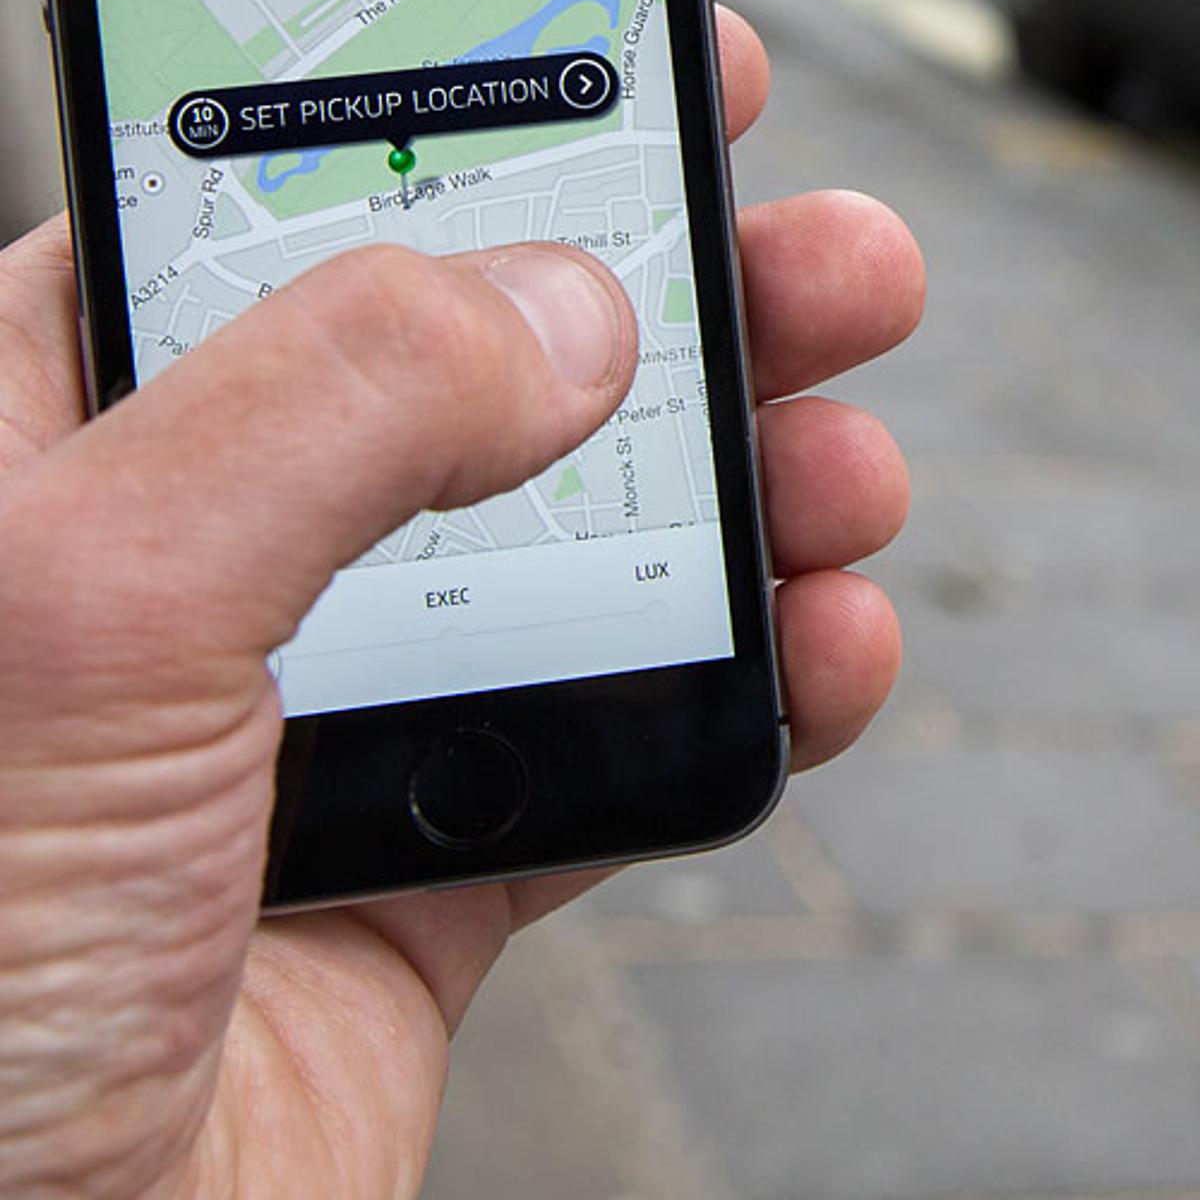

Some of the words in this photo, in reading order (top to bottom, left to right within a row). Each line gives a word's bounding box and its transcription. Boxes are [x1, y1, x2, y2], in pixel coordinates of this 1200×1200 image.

[621, 49, 637, 100] Horse
[193, 106, 213, 123] 10
[240, 103, 290, 131] SET
[299, 91, 402, 125] PICKUP
[412, 76, 549, 114] LOCATION
[189, 125, 219, 140] MIN
[202, 167, 224, 195] Rd
[368, 182, 446, 212] Birdcage
[449, 167, 493, 191] Walk
[193, 197, 216, 240] Spur
[611, 230, 632, 248] St
[130, 265, 179, 310] A3214
[616, 404, 662, 425] Peter
[666, 397, 687, 414] St
[616, 436, 632, 455] St
[618, 460, 640, 517] Monck
[635, 562, 670, 581] LUX
[425, 587, 471, 608] EXEC
